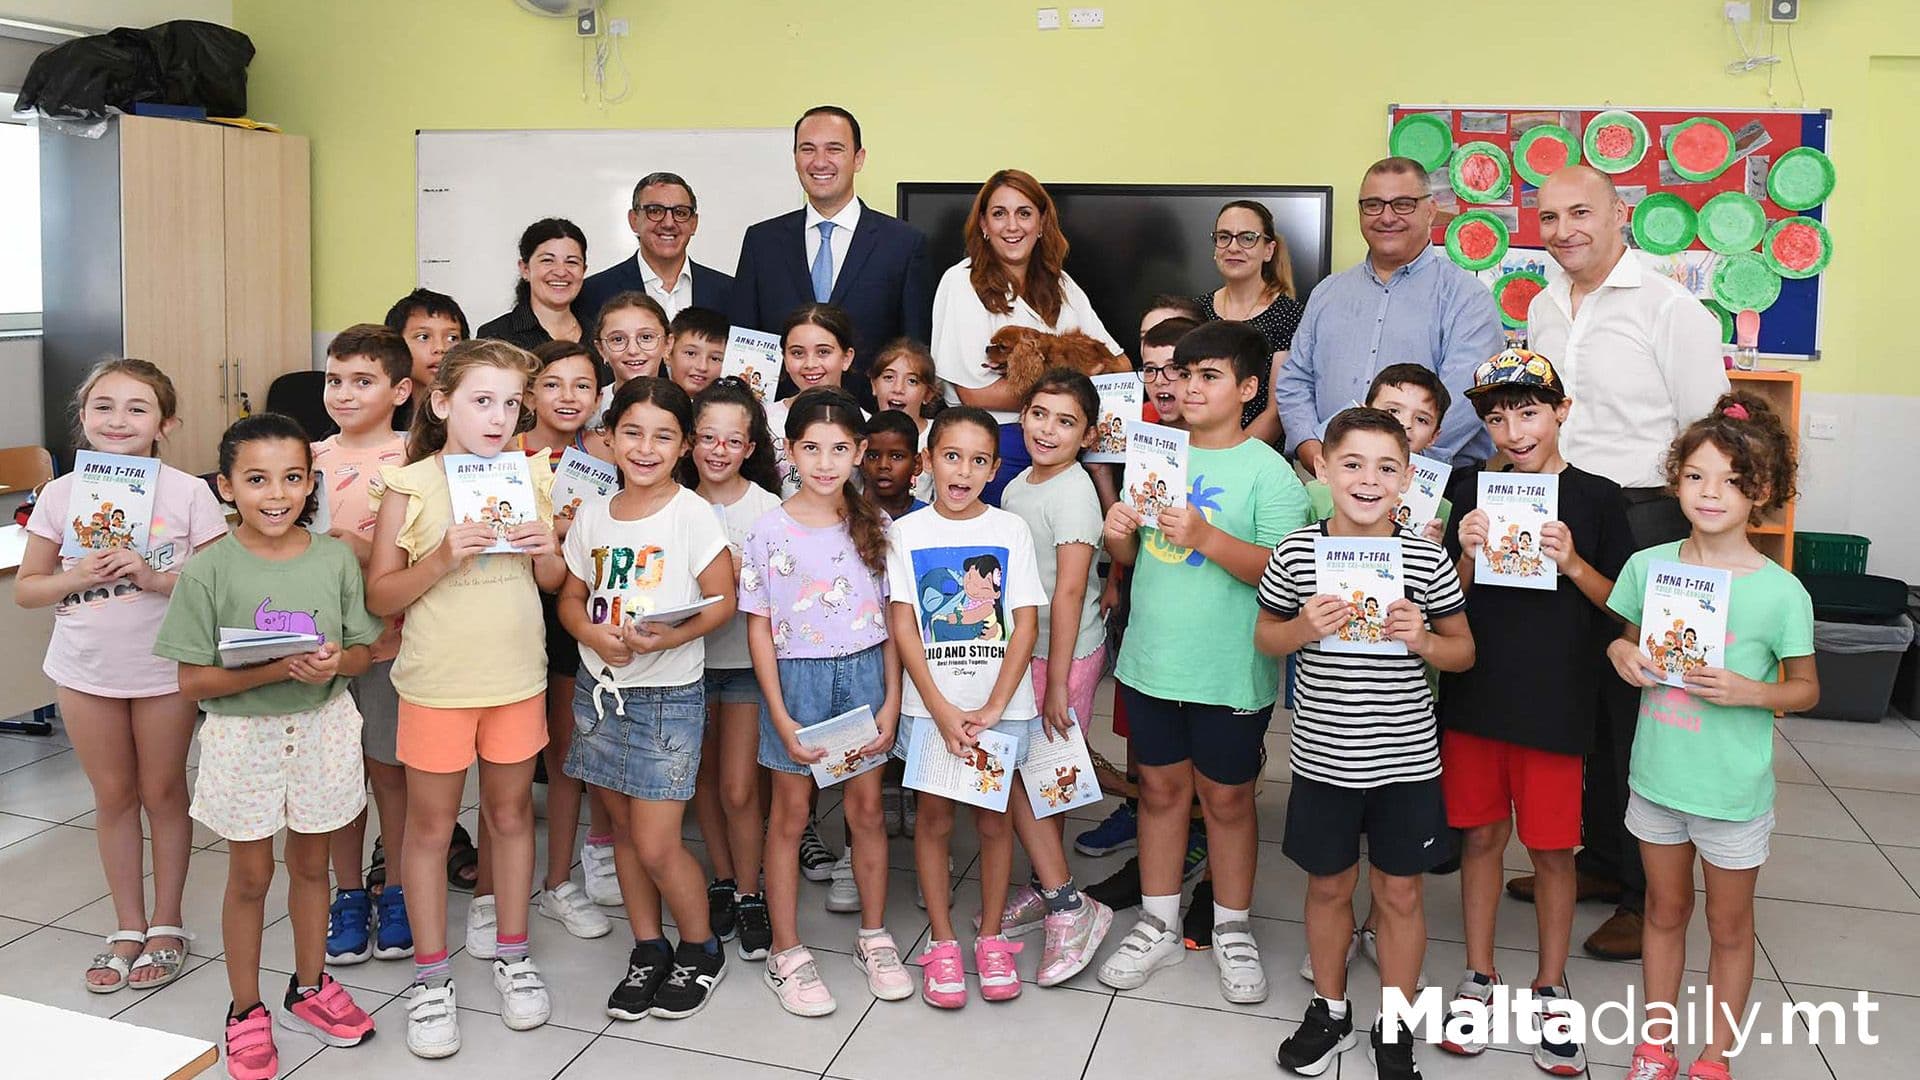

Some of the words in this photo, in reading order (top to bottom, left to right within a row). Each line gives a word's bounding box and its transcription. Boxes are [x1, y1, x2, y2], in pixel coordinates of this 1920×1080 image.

[1359, 551, 1391, 562] T-TFAL
[1685, 578, 1715, 592] T-TFAL
[944, 646, 966, 658] AND
[969, 645, 1005, 658] STITCH
